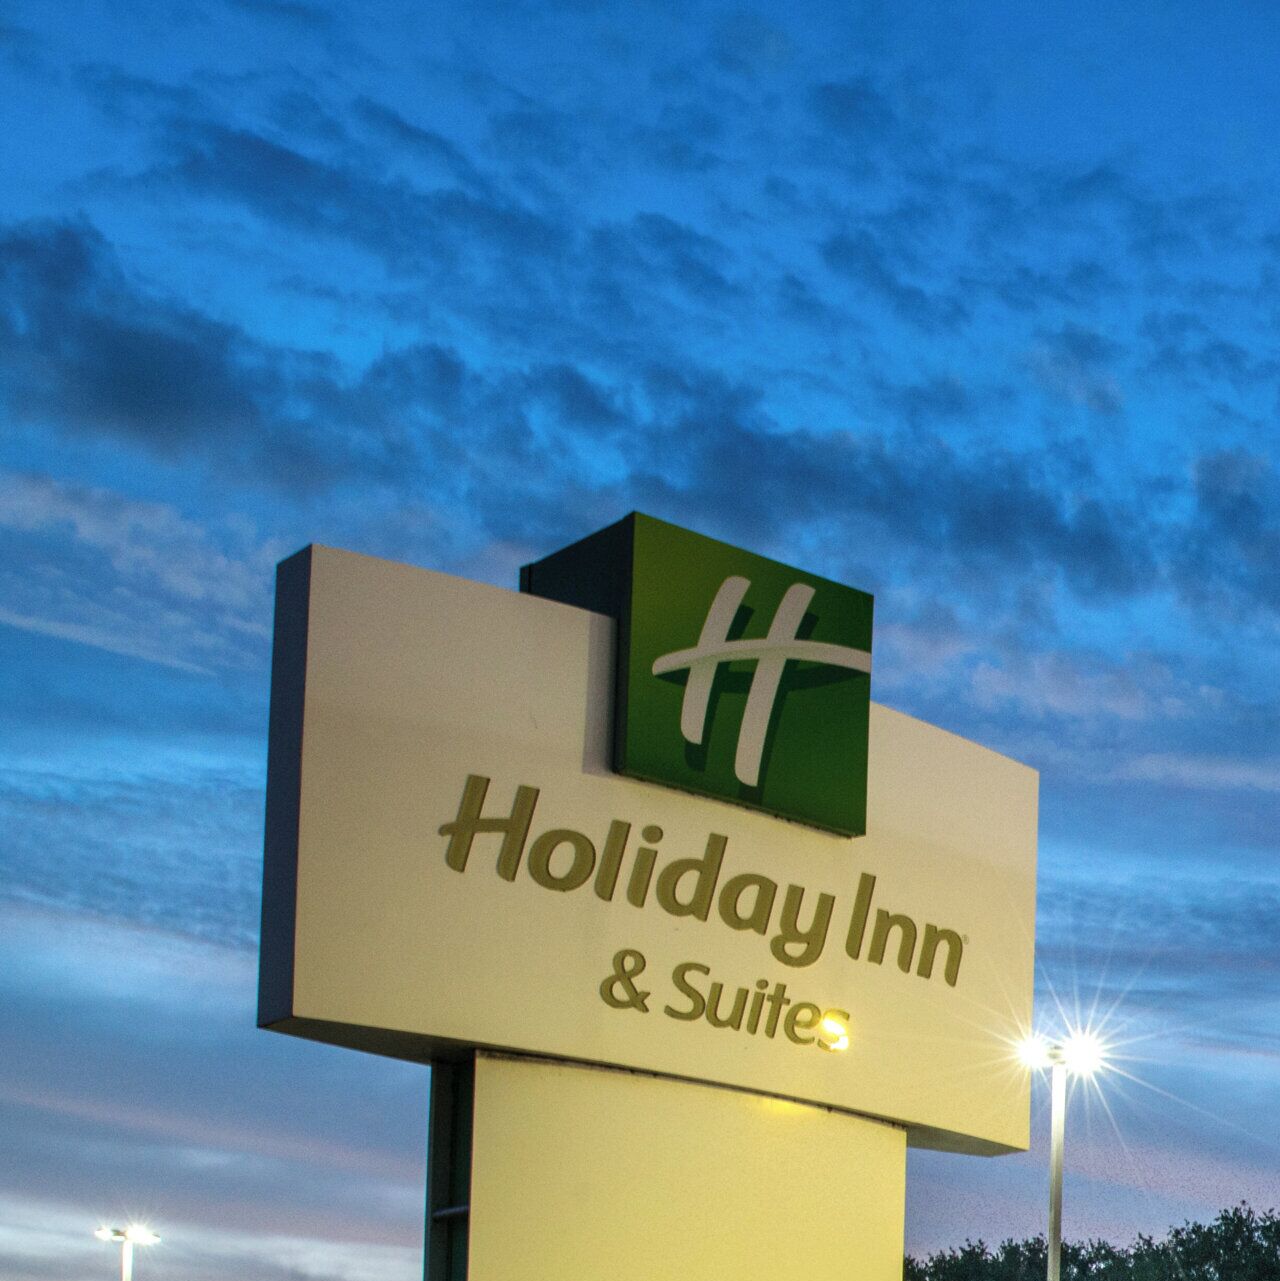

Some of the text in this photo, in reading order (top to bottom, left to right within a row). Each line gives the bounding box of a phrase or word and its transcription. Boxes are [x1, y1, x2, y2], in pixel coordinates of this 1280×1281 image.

[438, 773, 965, 987] Holiday Inn
[600, 949, 851, 1053] & Suites
